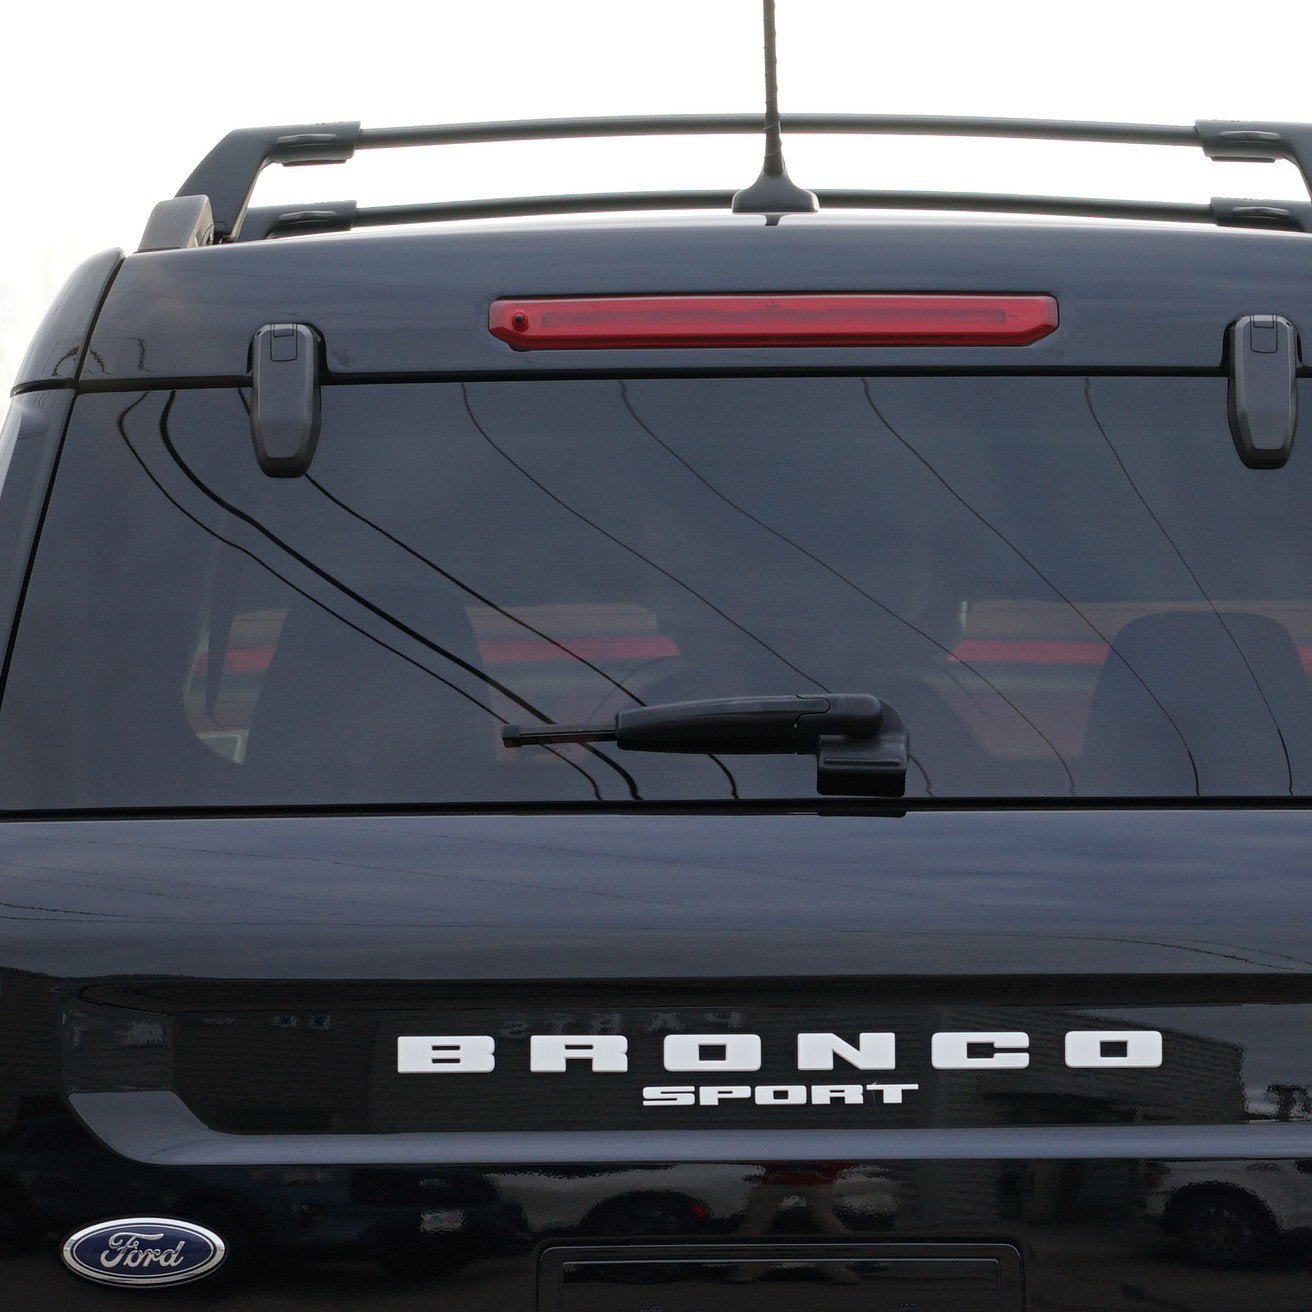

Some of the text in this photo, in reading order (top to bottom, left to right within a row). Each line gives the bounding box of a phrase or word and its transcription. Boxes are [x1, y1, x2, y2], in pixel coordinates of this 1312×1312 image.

[397, 1031, 1163, 1074] BRONCO
[642, 1083, 919, 1106] SPORT
[100, 1232, 186, 1268] Ford
